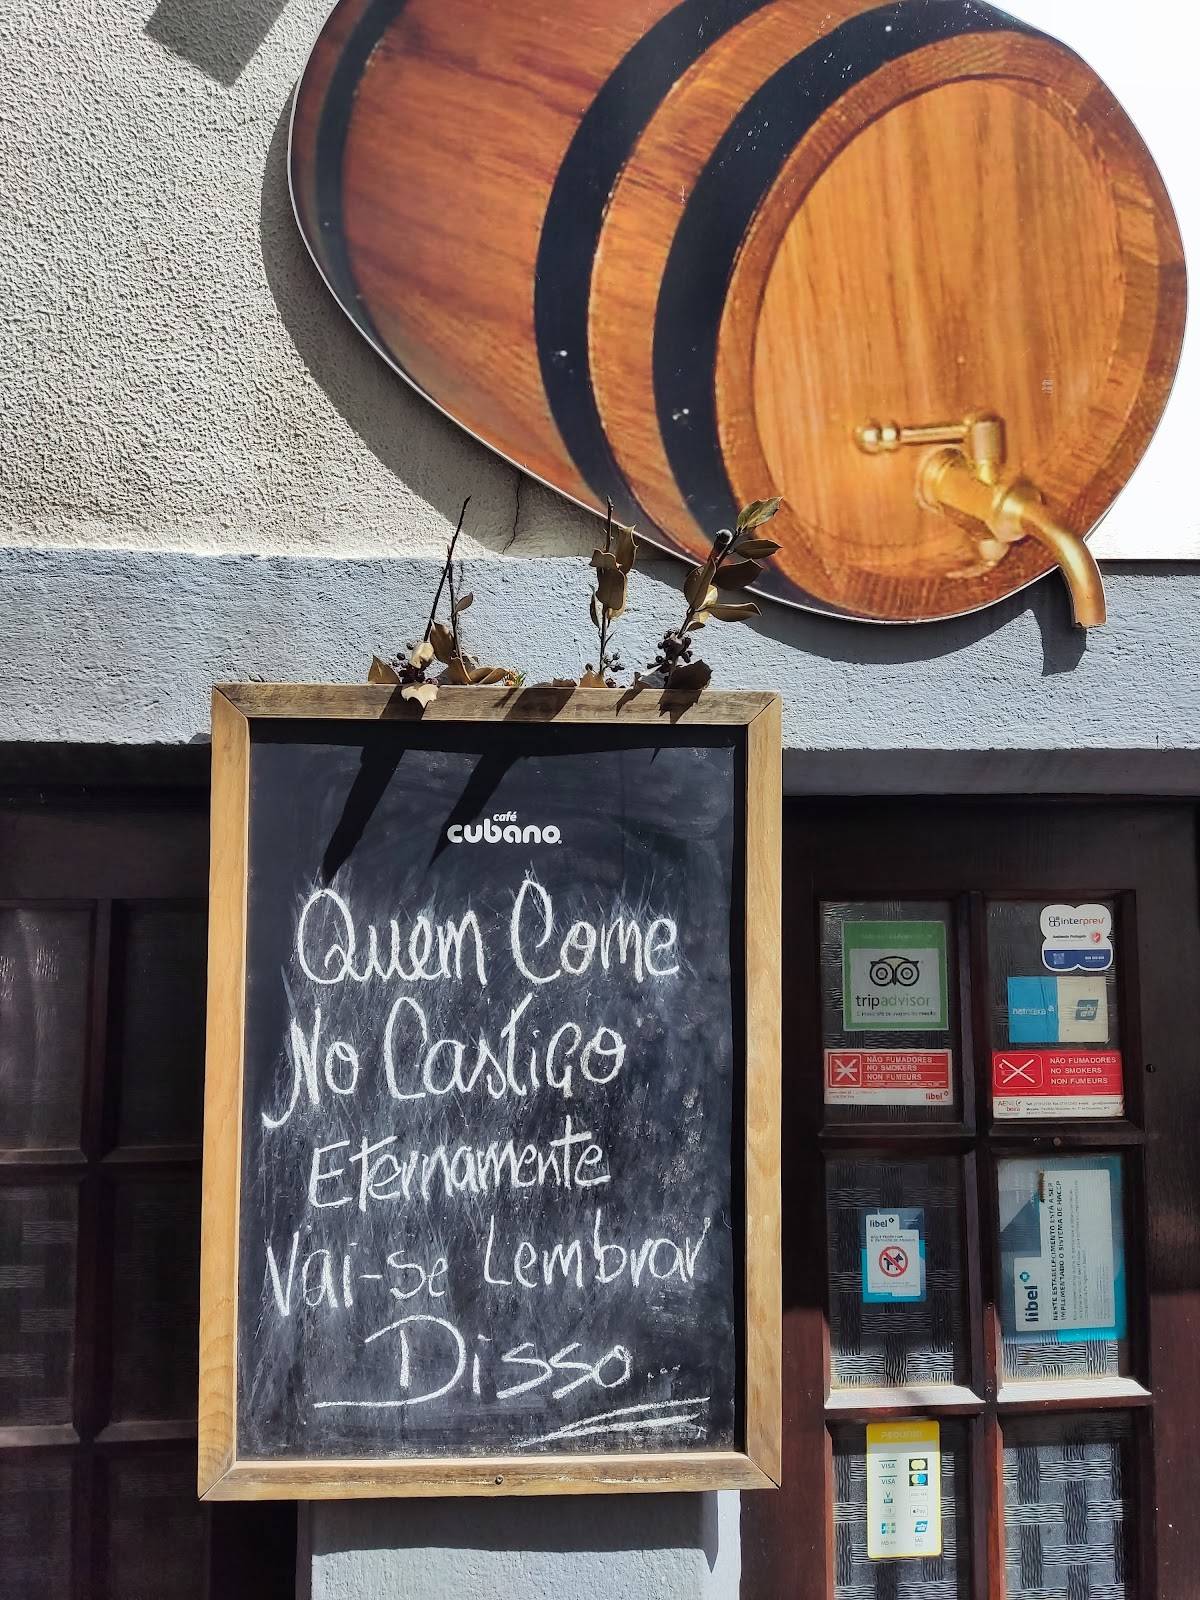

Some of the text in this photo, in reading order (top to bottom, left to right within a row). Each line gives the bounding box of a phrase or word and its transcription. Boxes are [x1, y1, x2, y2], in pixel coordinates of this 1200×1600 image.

[493, 811, 517, 822] café
[447, 819, 561, 844] cubano
[1060, 917, 1104, 926] interprev
[297, 880, 679, 986] Quem Come
[856, 994, 930, 1010] tripadvisor
[262, 1006, 359, 1128] No
[866, 1055, 883, 1063] NÃO
[1050, 1056, 1117, 1064] NÃO FUMADORES
[308, 1115, 611, 1212] Eternamente
[1056, 1207, 1063, 1217] DE
[869, 1219, 888, 1228] libel
[266, 1209, 710, 1316] Vai-se Lembrar
[1024, 1285, 1038, 1322] libel
